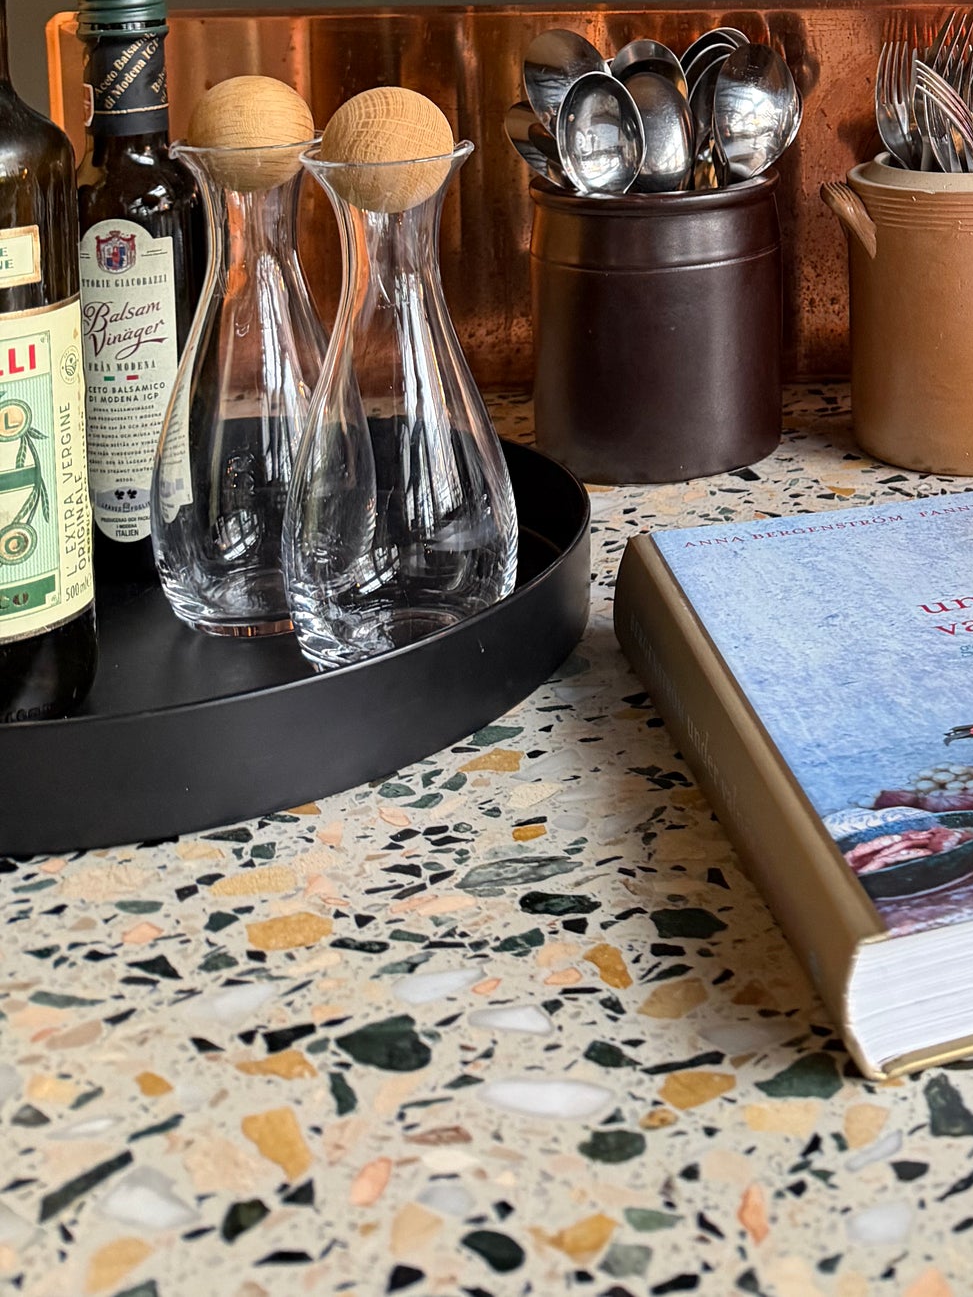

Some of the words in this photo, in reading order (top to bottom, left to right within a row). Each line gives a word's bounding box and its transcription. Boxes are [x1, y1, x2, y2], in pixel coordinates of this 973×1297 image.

[104, 96, 116, 110] di
[111, 59, 147, 99] Modena
[83, 301, 162, 336] Balsam
[89, 319, 168, 361] Vinäger
[88, 361, 111, 372] FRÅN
[116, 359, 156, 372] MODENA
[89, 395, 97, 403] DI
[100, 394, 139, 404] MODENA
[143, 392, 159, 401] IGP
[112, 382, 166, 394] BALSAMICO
[59, 402, 73, 485] VERGINE
[63, 493, 77, 555] EXTRA
[74, 471, 87, 571] ORIGINALE
[684, 535, 746, 549] ANNA
[751, 514, 904, 541] BERGENSTRÖM
